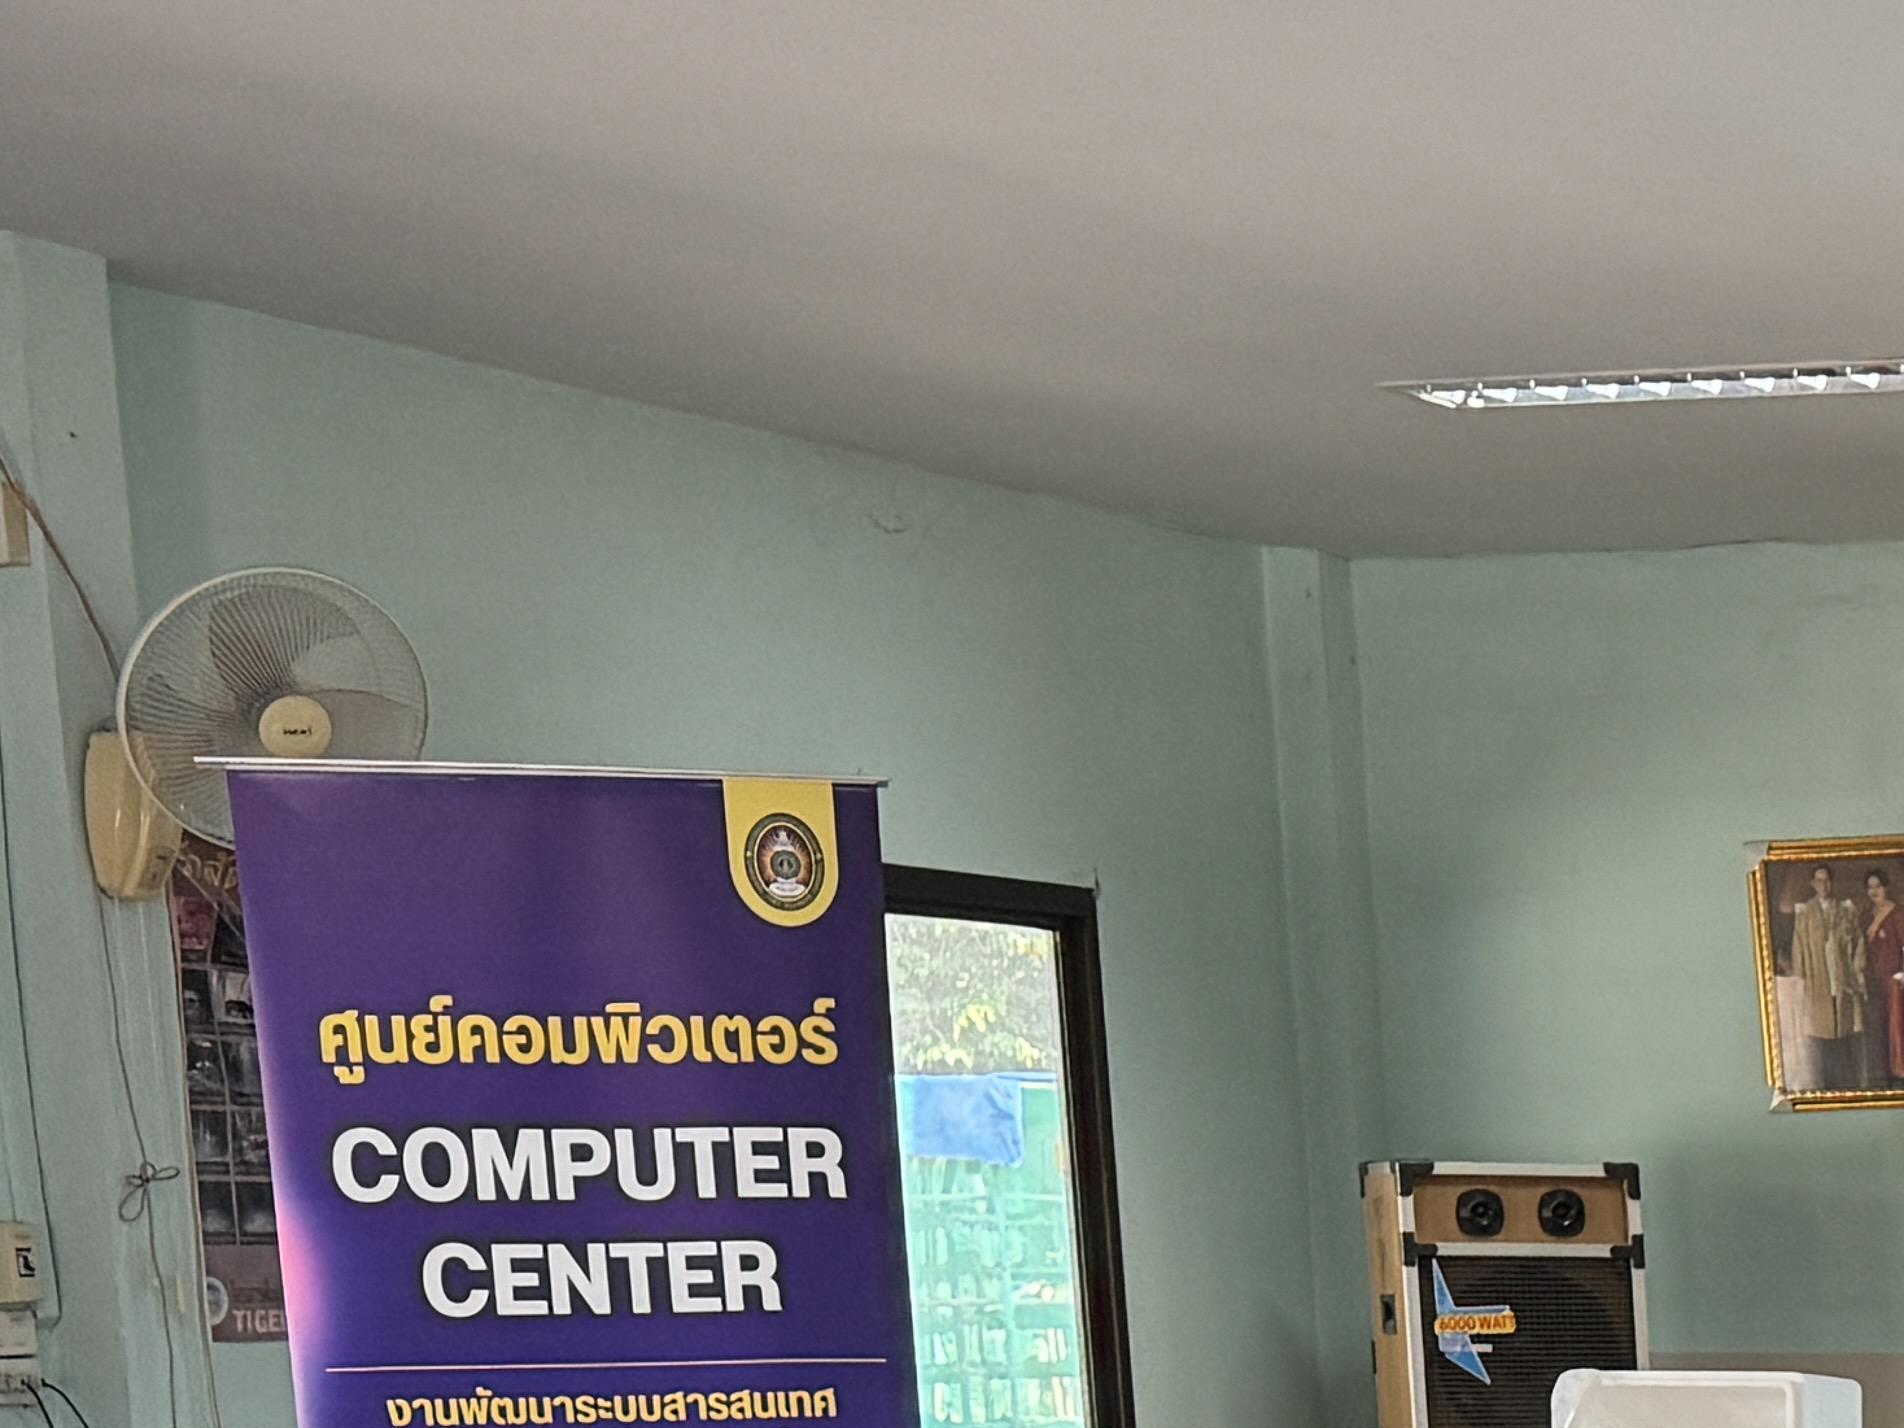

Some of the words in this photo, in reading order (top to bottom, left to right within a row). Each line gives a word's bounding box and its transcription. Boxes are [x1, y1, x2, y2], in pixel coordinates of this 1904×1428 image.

[319, 995, 838, 1085] ศูนย์คอมพิวเตอร์
[331, 1126, 848, 1203] COMPUTER
[422, 1240, 783, 1316] CENTER
[231, 1309, 286, 1334] TIGE
[387, 1387, 836, 1428] งานพัฒนาระบบสารสนเทศ
